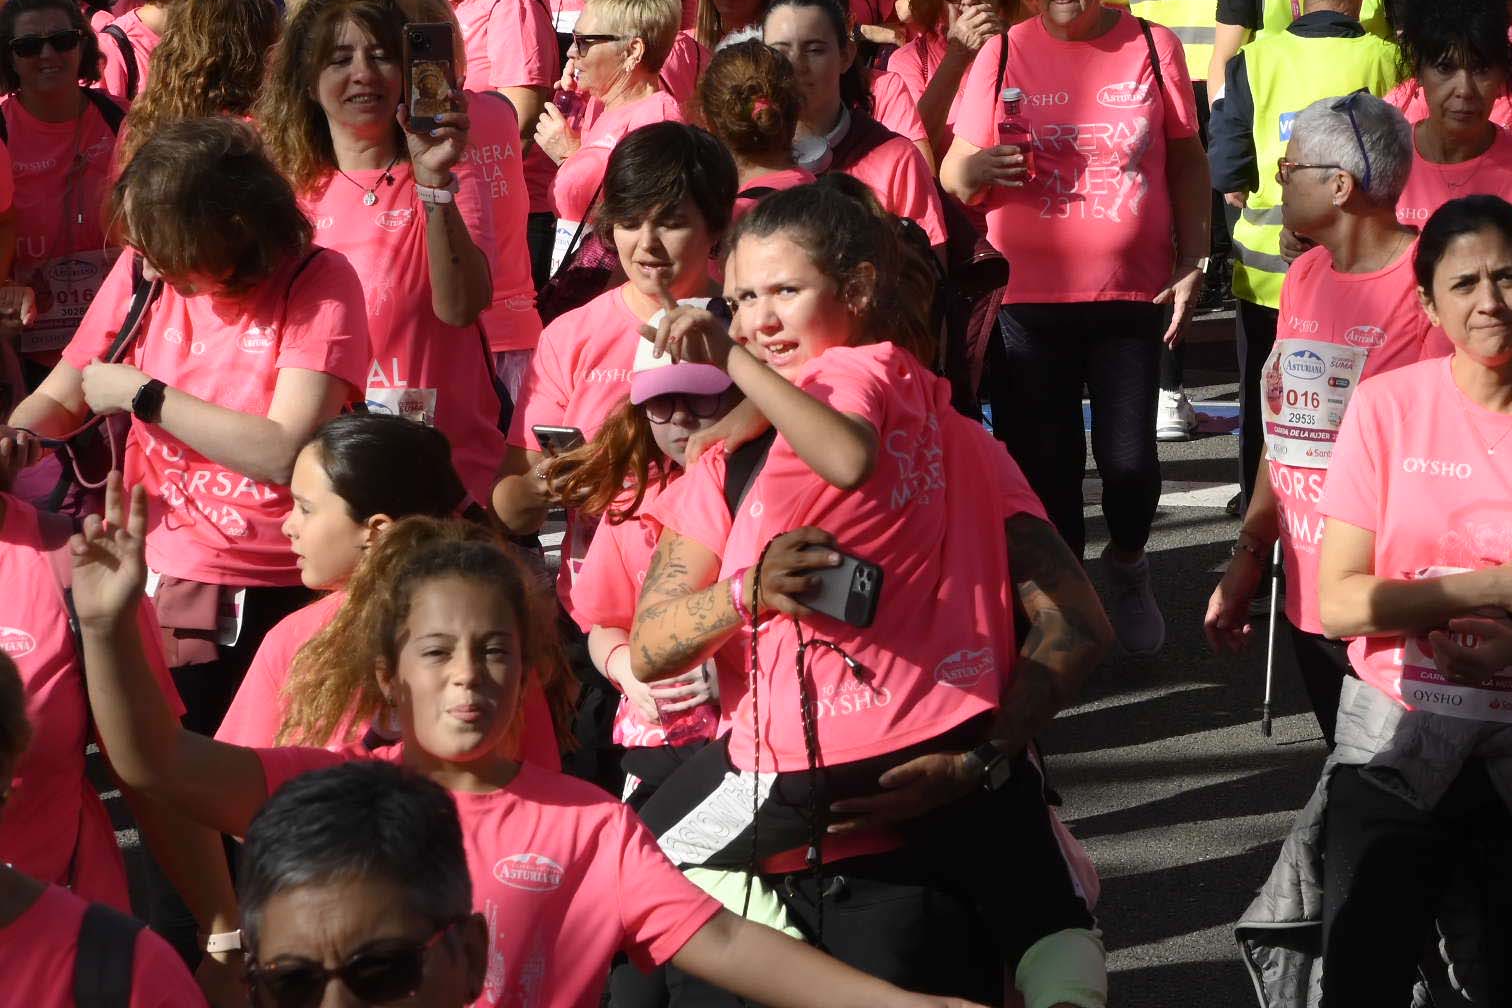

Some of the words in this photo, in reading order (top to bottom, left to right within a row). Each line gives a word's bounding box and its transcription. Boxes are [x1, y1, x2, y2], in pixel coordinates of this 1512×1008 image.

[1022, 91, 1069, 106] YSHO
[1286, 362, 1326, 376] ASTURIANA
[1286, 388, 1321, 410] 016
[1402, 457, 1472, 480] OYSHO
[1414, 689, 1463, 707] OYSHO
